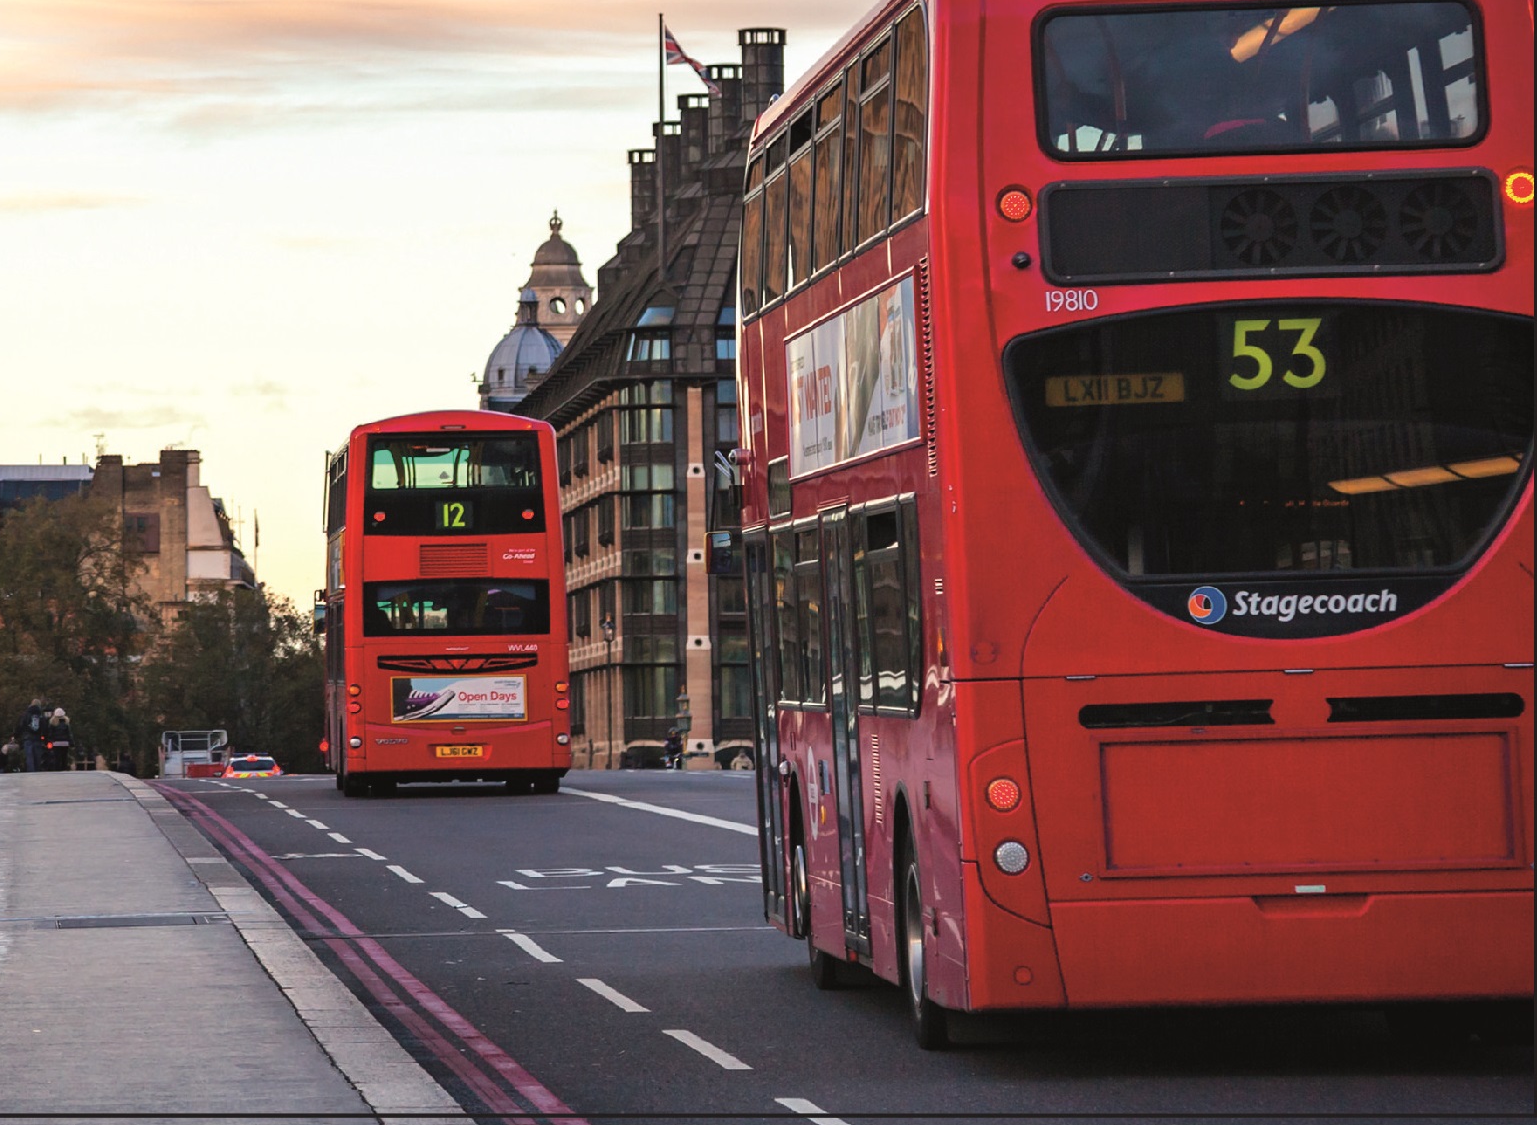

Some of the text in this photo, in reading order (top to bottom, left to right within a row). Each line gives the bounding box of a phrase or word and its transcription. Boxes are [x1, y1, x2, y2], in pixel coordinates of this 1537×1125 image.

[1045, 290, 1098, 311] 19810
[1229, 318, 1327, 390] 53
[1064, 377, 1164, 402] LX11 BJZ
[443, 503, 465, 527] 12
[1232, 589, 1397, 622] Stagecoach
[458, 691, 517, 704] Open Days
[515, 864, 761, 878] BUS
[495, 876, 762, 890] LAN
